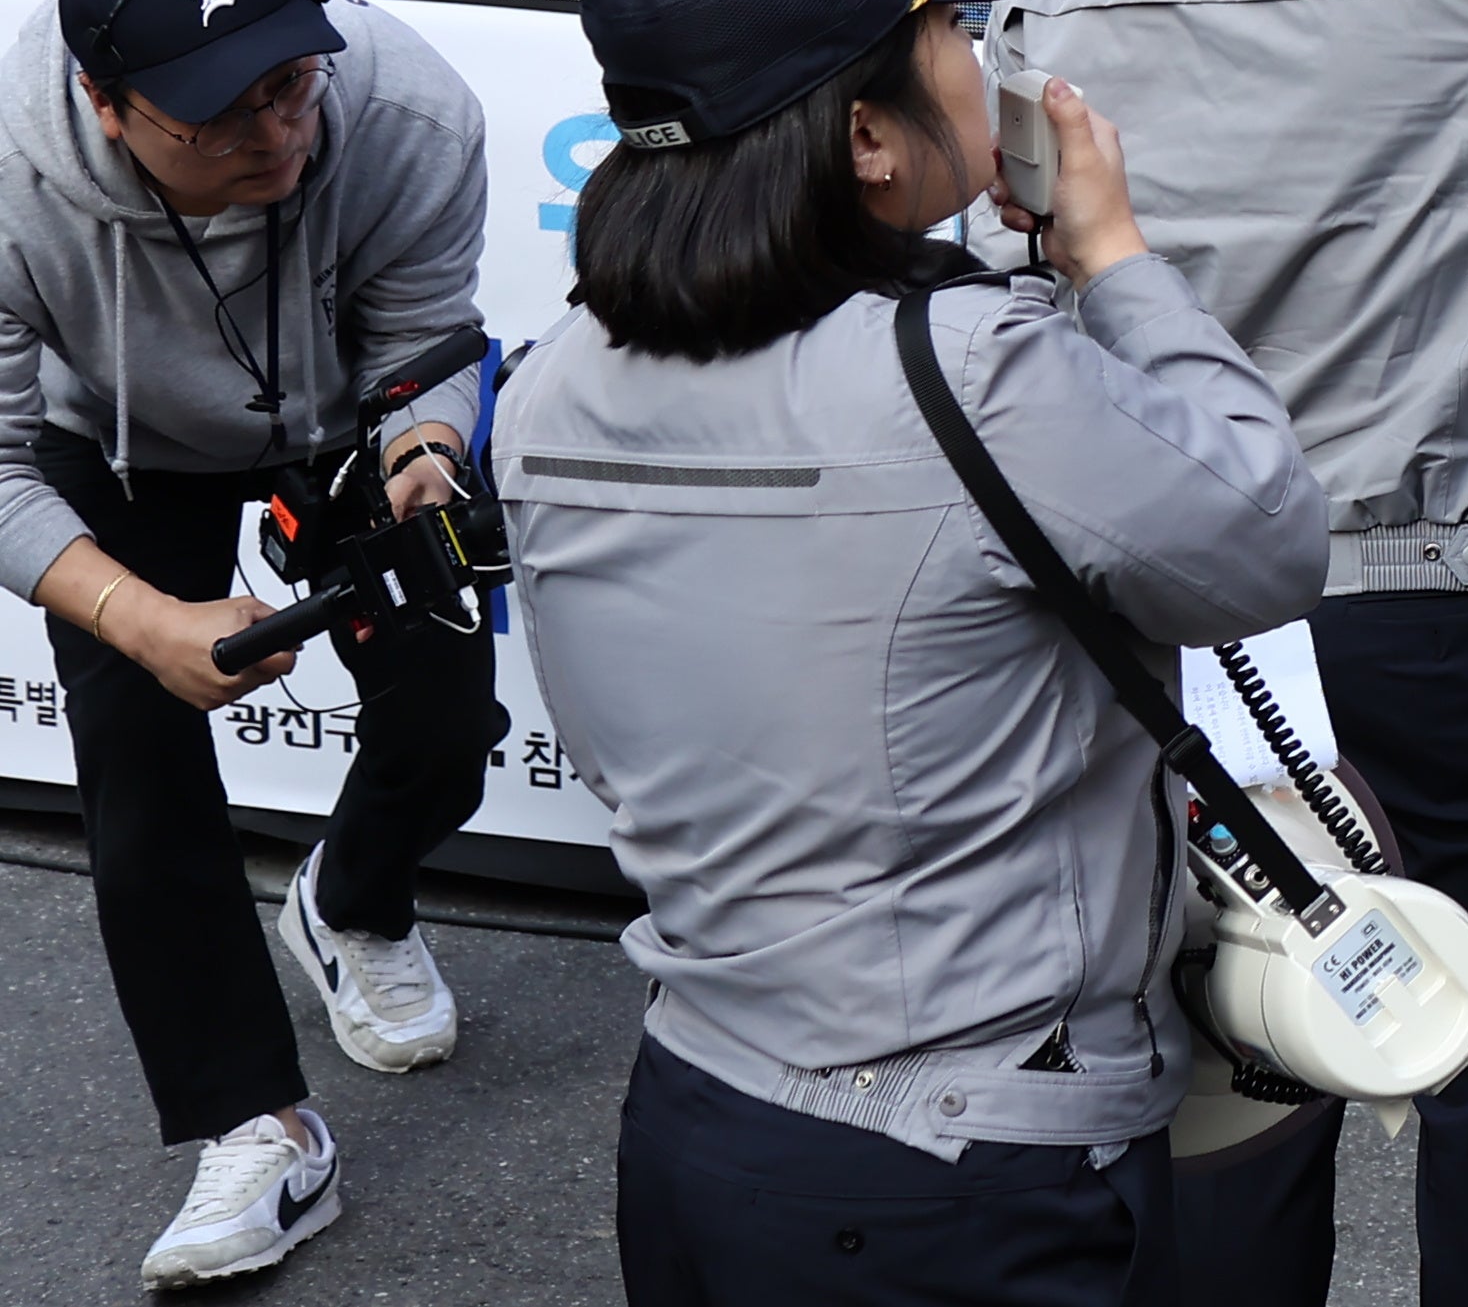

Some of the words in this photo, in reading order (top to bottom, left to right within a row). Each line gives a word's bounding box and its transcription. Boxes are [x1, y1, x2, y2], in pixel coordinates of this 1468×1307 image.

[521, 731, 578, 790] 참
[1339, 966, 1353, 982] HI
[1351, 938, 1385, 972] POWER
